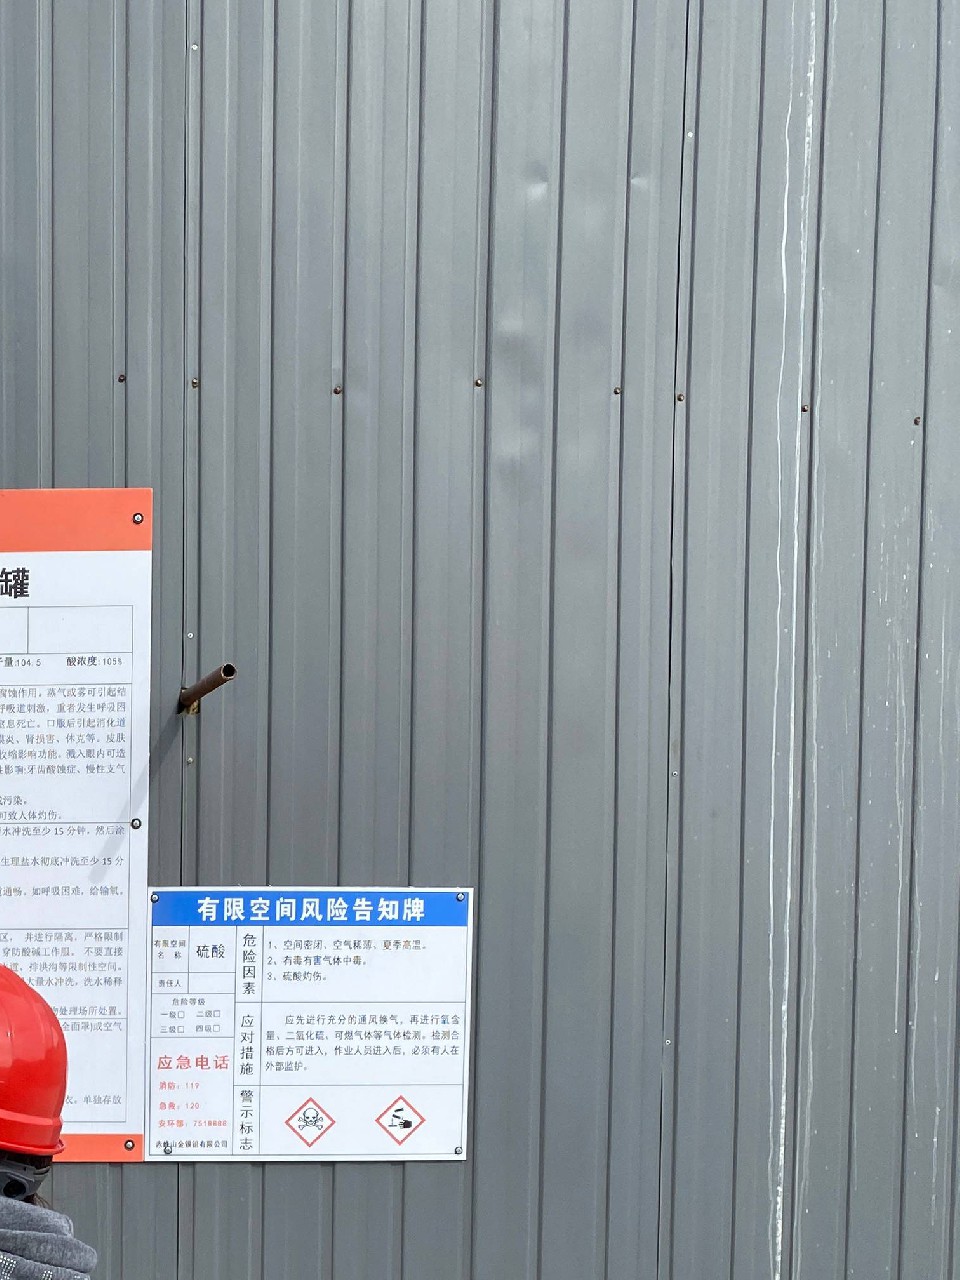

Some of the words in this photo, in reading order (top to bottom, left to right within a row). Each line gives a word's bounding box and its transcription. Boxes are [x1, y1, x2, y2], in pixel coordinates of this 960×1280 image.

[197, 897, 425, 922] 有限空间风险告知牌
[154, 939, 186, 948] 有限空间
[196, 943, 225, 959] 硫酸
[242, 933, 257, 995] 危险因素
[158, 979, 182, 988] 责任人
[172, 998, 206, 1006] 危险等级
[239, 1013, 255, 1076] 应对措施
[157, 1055, 230, 1070] 应急电话
[239, 1089, 254, 1151] 警示标志
